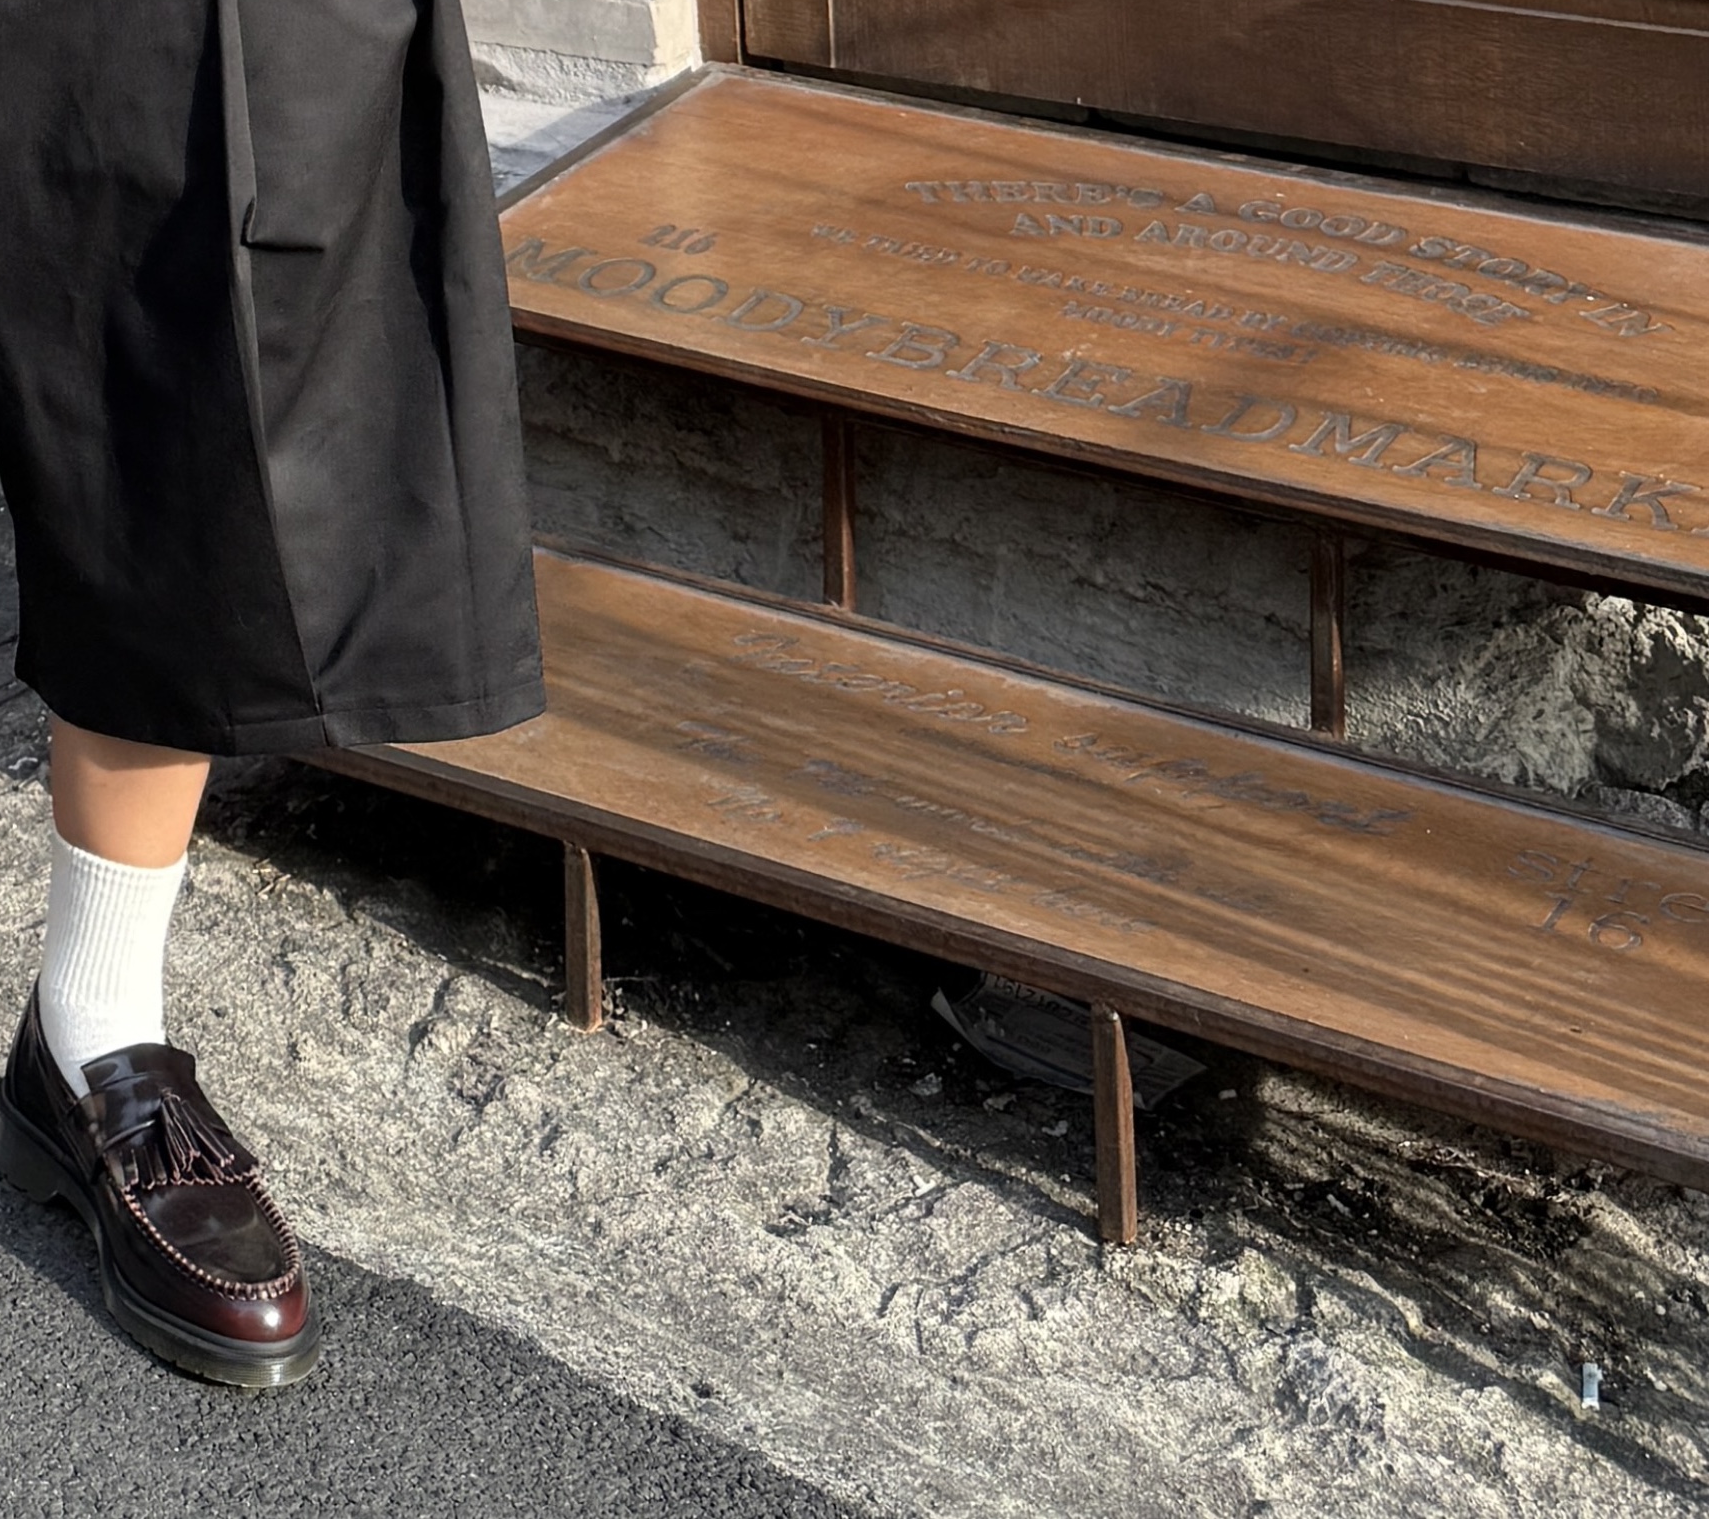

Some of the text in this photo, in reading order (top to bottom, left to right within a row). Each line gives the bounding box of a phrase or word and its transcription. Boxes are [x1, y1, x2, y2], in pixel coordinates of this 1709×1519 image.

[638, 223, 719, 256] 216
[905, 180, 1677, 339] THERE'S A GOOD STORY IN
[1008, 211, 1124, 240] AND
[1133, 218, 1360, 274] AROUND
[504, 236, 1709, 538] MOODYBREADMARK
